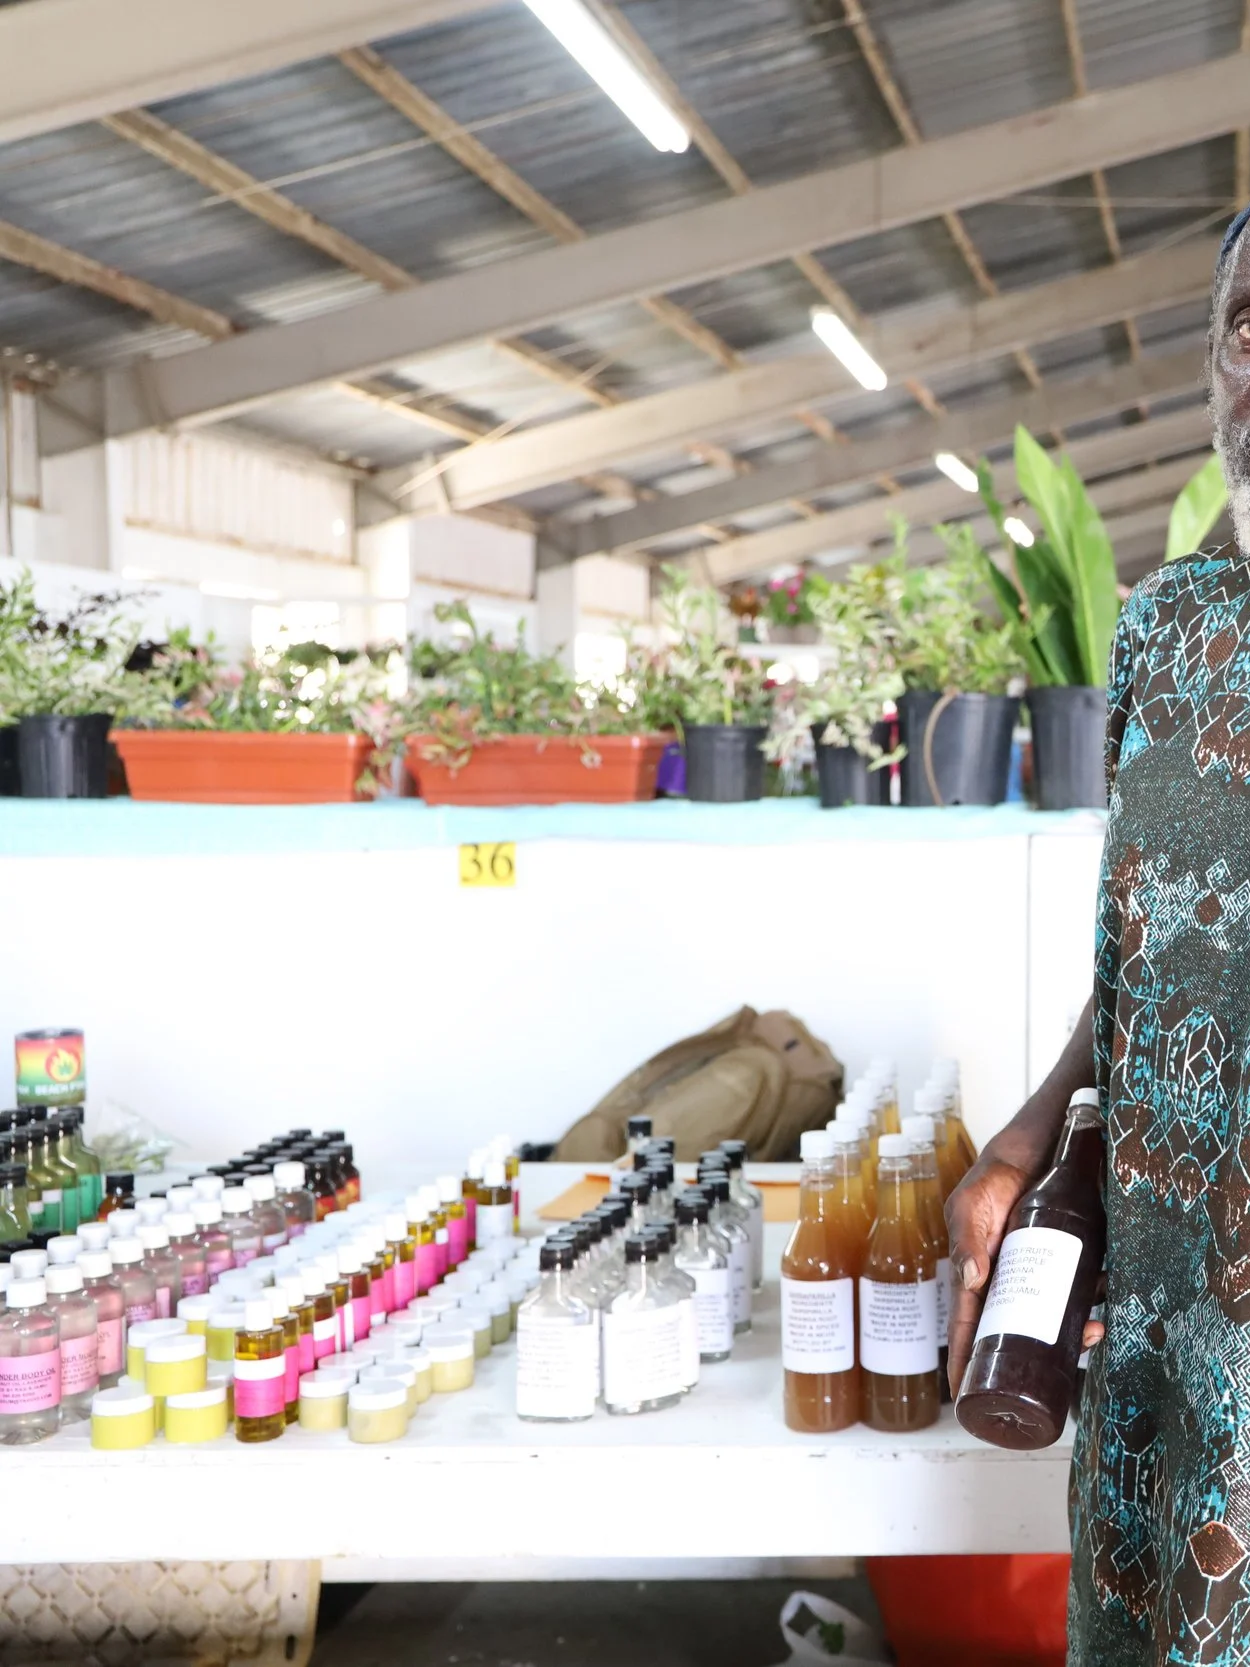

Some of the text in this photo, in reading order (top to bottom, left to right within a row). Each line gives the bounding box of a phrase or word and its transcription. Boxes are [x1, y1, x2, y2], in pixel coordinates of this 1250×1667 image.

[461, 842, 513, 882] 36
[1020, 1246, 1054, 1257] FRUITS
[1008, 1286, 1041, 1297] AJAMU
[21, 1370, 45, 1380] BODY
